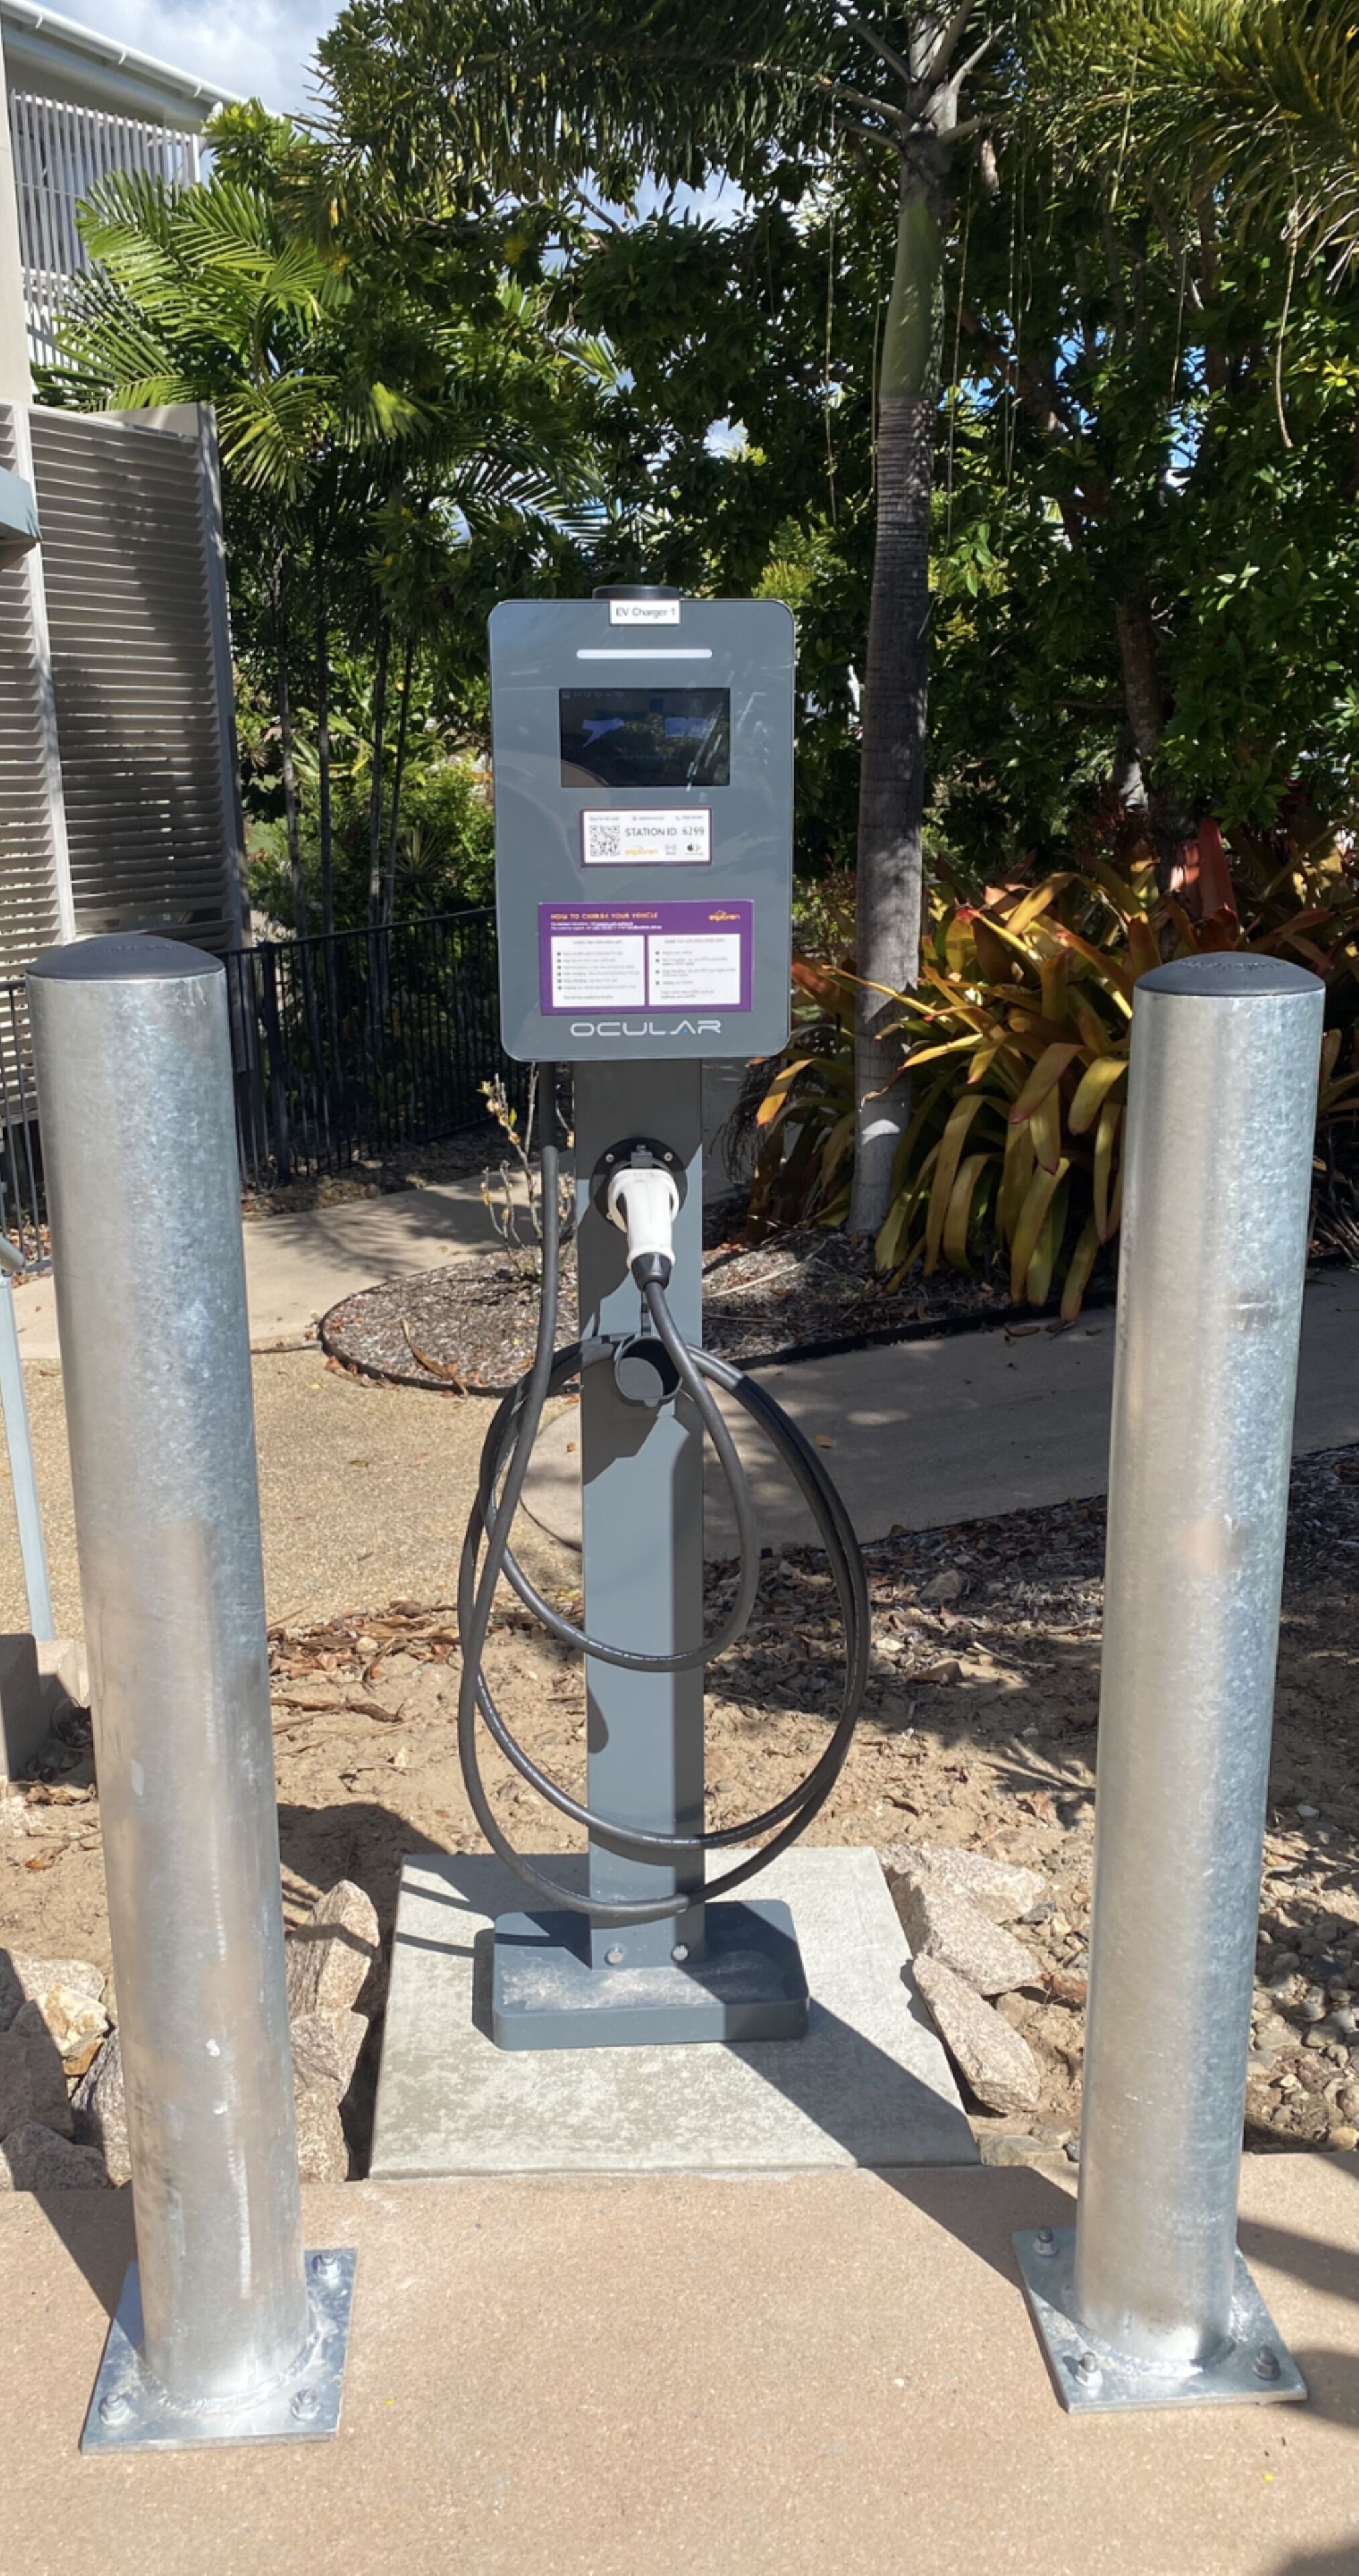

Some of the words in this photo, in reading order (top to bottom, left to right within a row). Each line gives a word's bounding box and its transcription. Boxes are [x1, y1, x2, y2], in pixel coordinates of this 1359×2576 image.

[616, 607, 629, 616] EV
[631, 606, 667, 619] Charger
[671, 607, 676, 616] 1
[624, 827, 665, 837] STATION
[667, 827, 677, 837] ID
[682, 826, 704, 836] 6299
[570, 1020, 722, 1037] OCULAR
